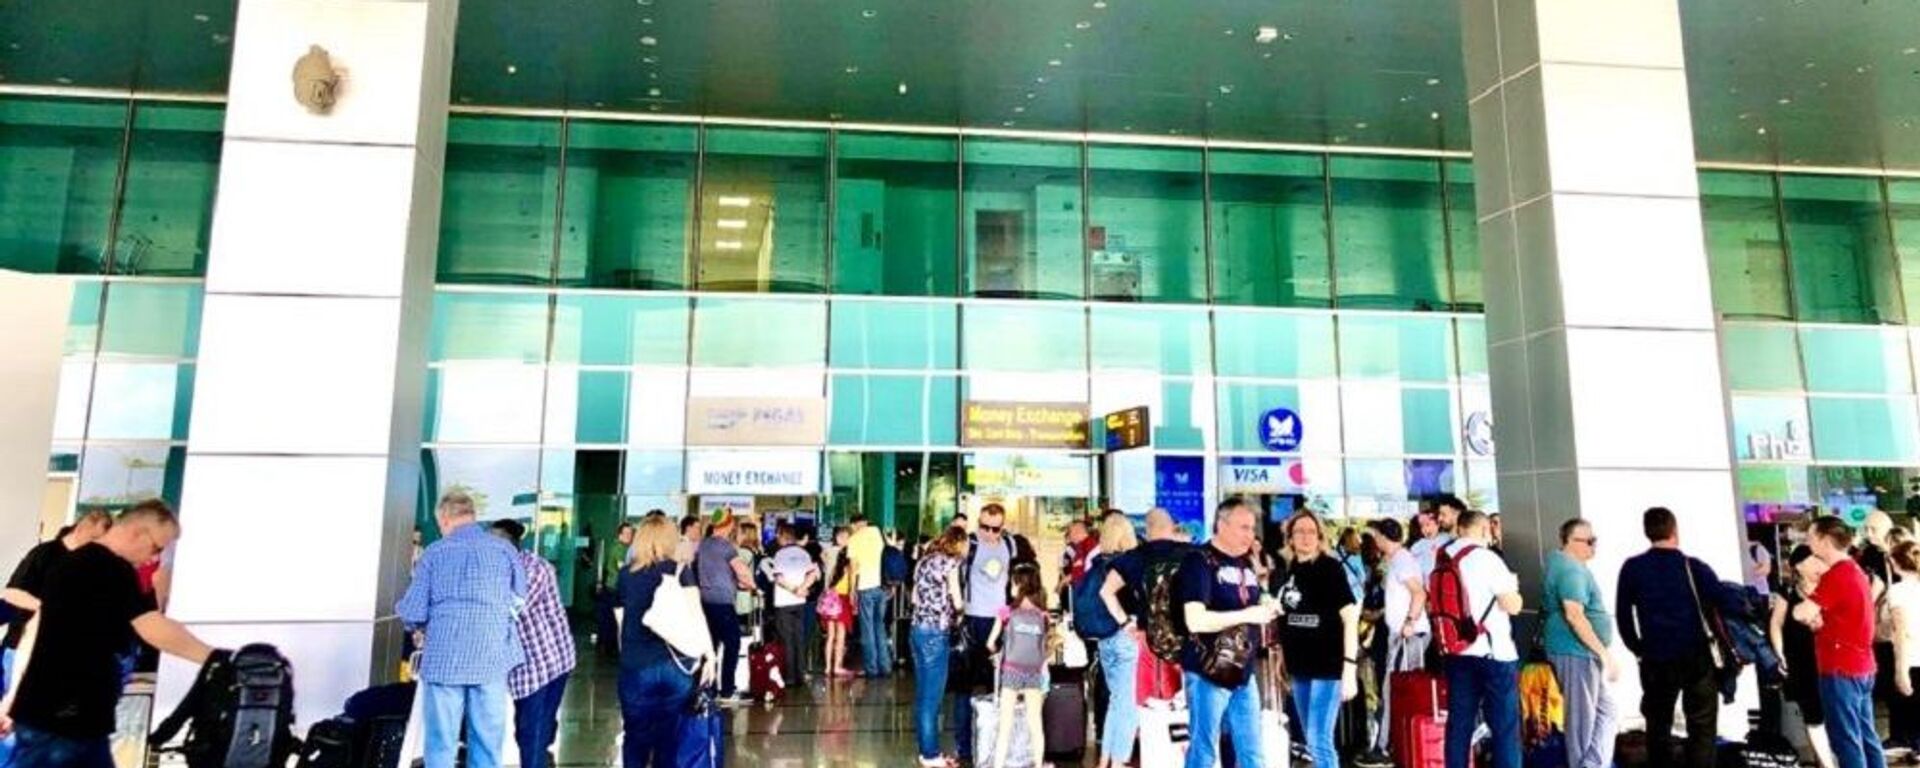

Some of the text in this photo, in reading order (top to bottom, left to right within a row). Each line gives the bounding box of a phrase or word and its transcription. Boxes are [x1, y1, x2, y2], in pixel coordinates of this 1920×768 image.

[969, 406, 1082, 427] Money Exchange
[703, 470, 803, 485] MONEY EXCHANGE
[1233, 468, 1268, 482] VISA
